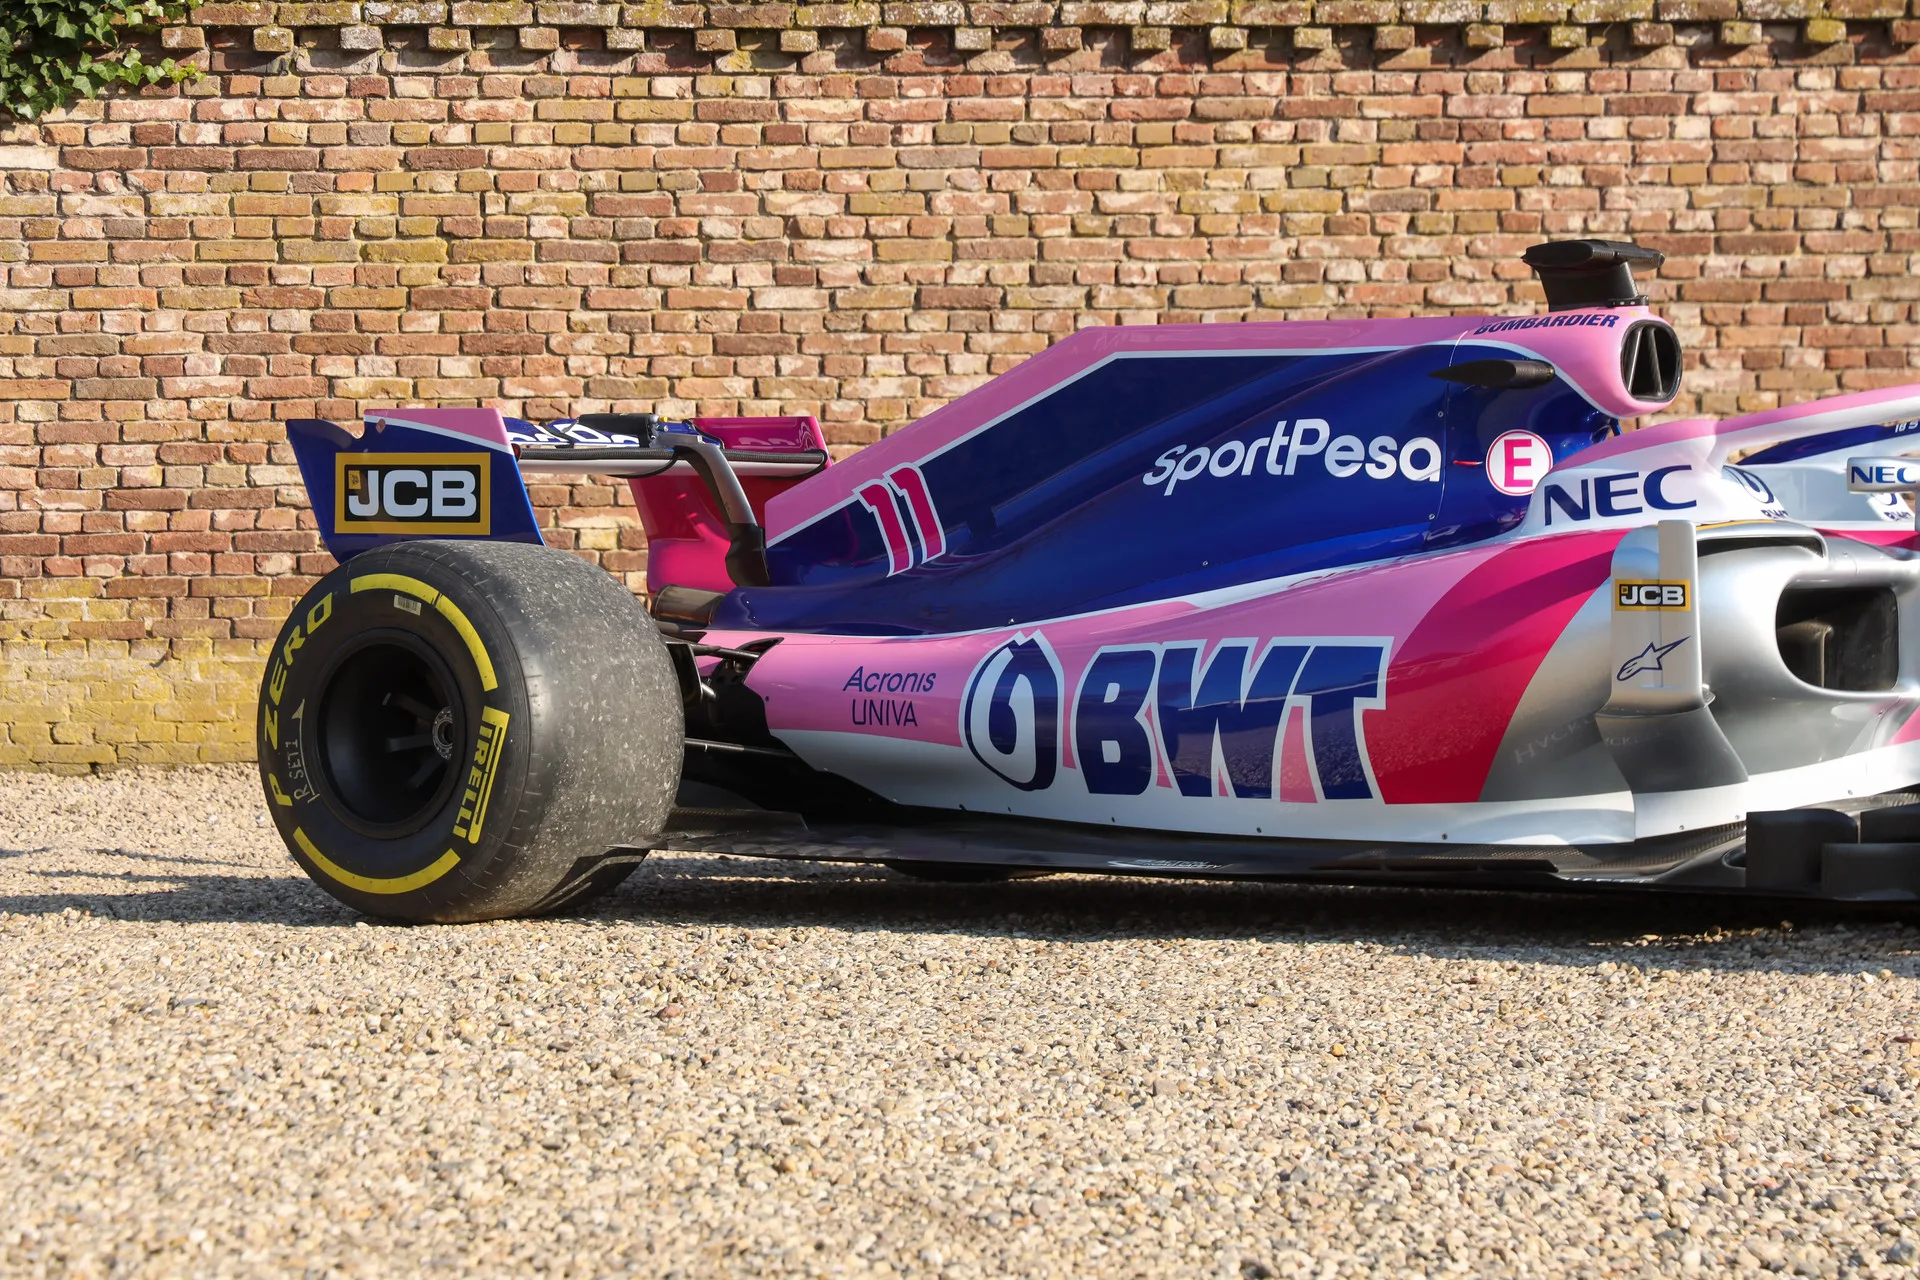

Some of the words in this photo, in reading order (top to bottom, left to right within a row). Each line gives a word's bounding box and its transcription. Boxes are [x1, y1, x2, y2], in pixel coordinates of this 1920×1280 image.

[1473, 314, 1620, 335] BOMBARDIER
[1142, 418, 1442, 496] SportPesa
[1503, 438, 1534, 488] E
[1851, 466, 1917, 484] NEC
[348, 469, 477, 517] JCB
[1544, 464, 1697, 526] NEC
[852, 462, 947, 577] 11
[1620, 585, 1685, 605] JCB
[264, 592, 333, 750] ZERO
[842, 665, 937, 692] Acronis
[852, 699, 918, 726] UNIVA
[1073, 638, 1391, 801] BWT
[268, 773, 293, 807] P
[453, 705, 510, 844] PIRELLI
